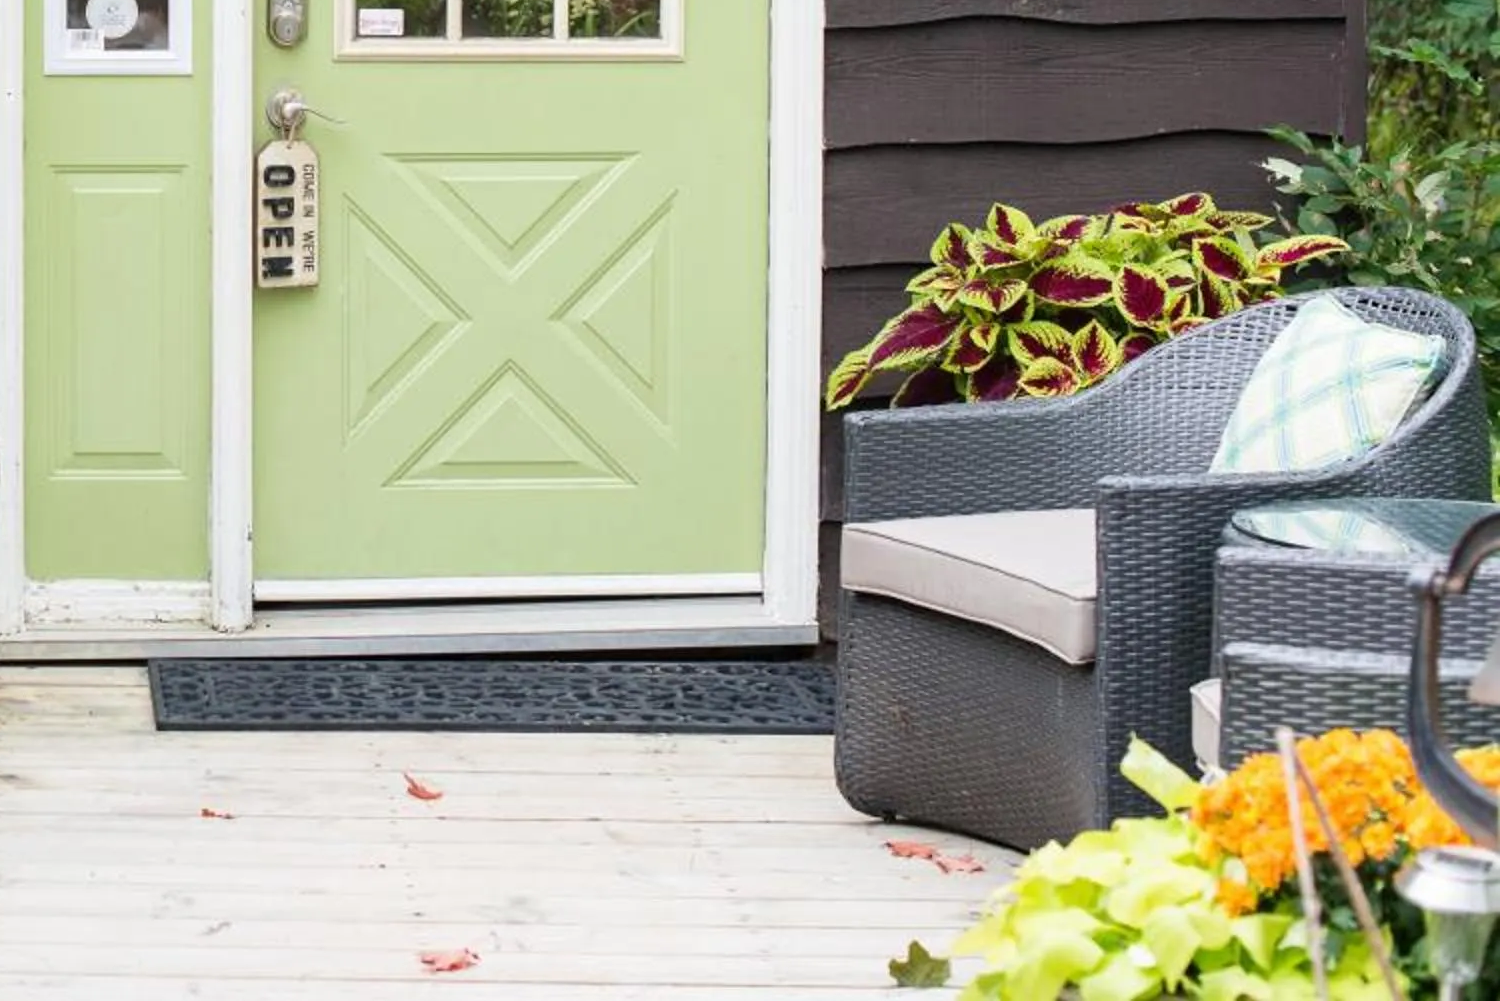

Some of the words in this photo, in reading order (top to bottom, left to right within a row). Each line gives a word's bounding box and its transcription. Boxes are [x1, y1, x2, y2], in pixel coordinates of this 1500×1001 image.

[302, 164, 315, 200] COME
[262, 164, 296, 279] OPEN
[302, 205, 315, 218] IN
[302, 230, 315, 273] WE'RE
